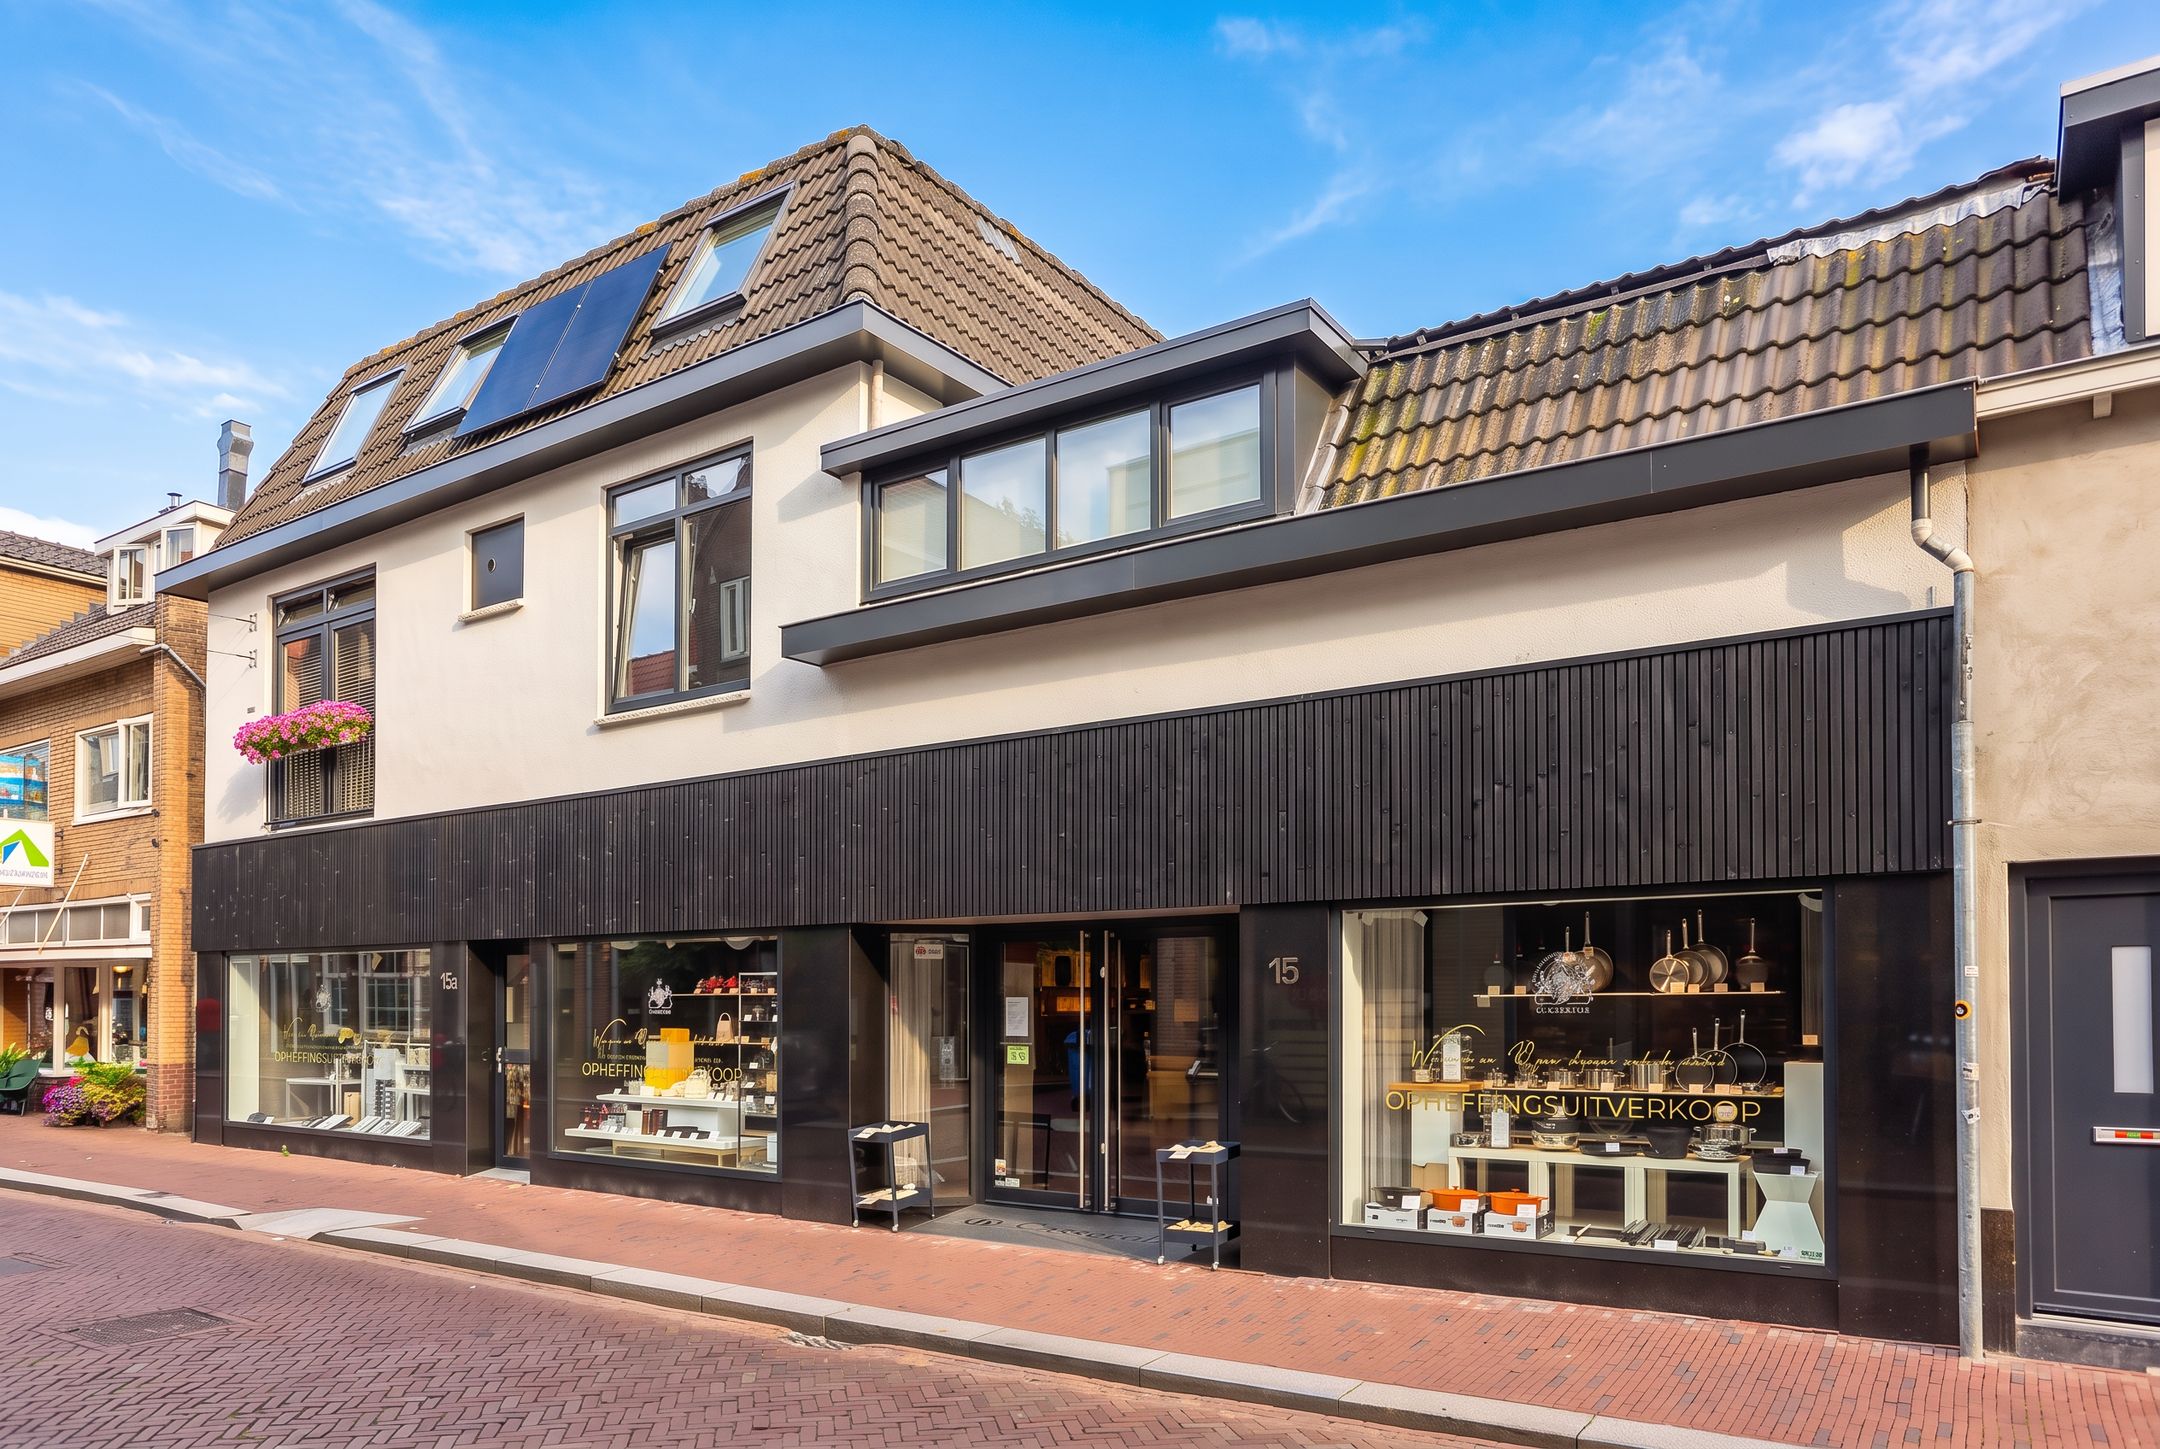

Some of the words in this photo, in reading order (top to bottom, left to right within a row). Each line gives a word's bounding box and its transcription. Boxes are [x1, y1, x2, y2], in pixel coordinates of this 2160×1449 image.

[440, 972, 458, 990] 15a
[1268, 957, 1300, 985] 15
[1386, 1091, 1761, 1123] OPHEFFINGSUITVERKOOP
[1016, 1222, 1162, 1244] Casserol
